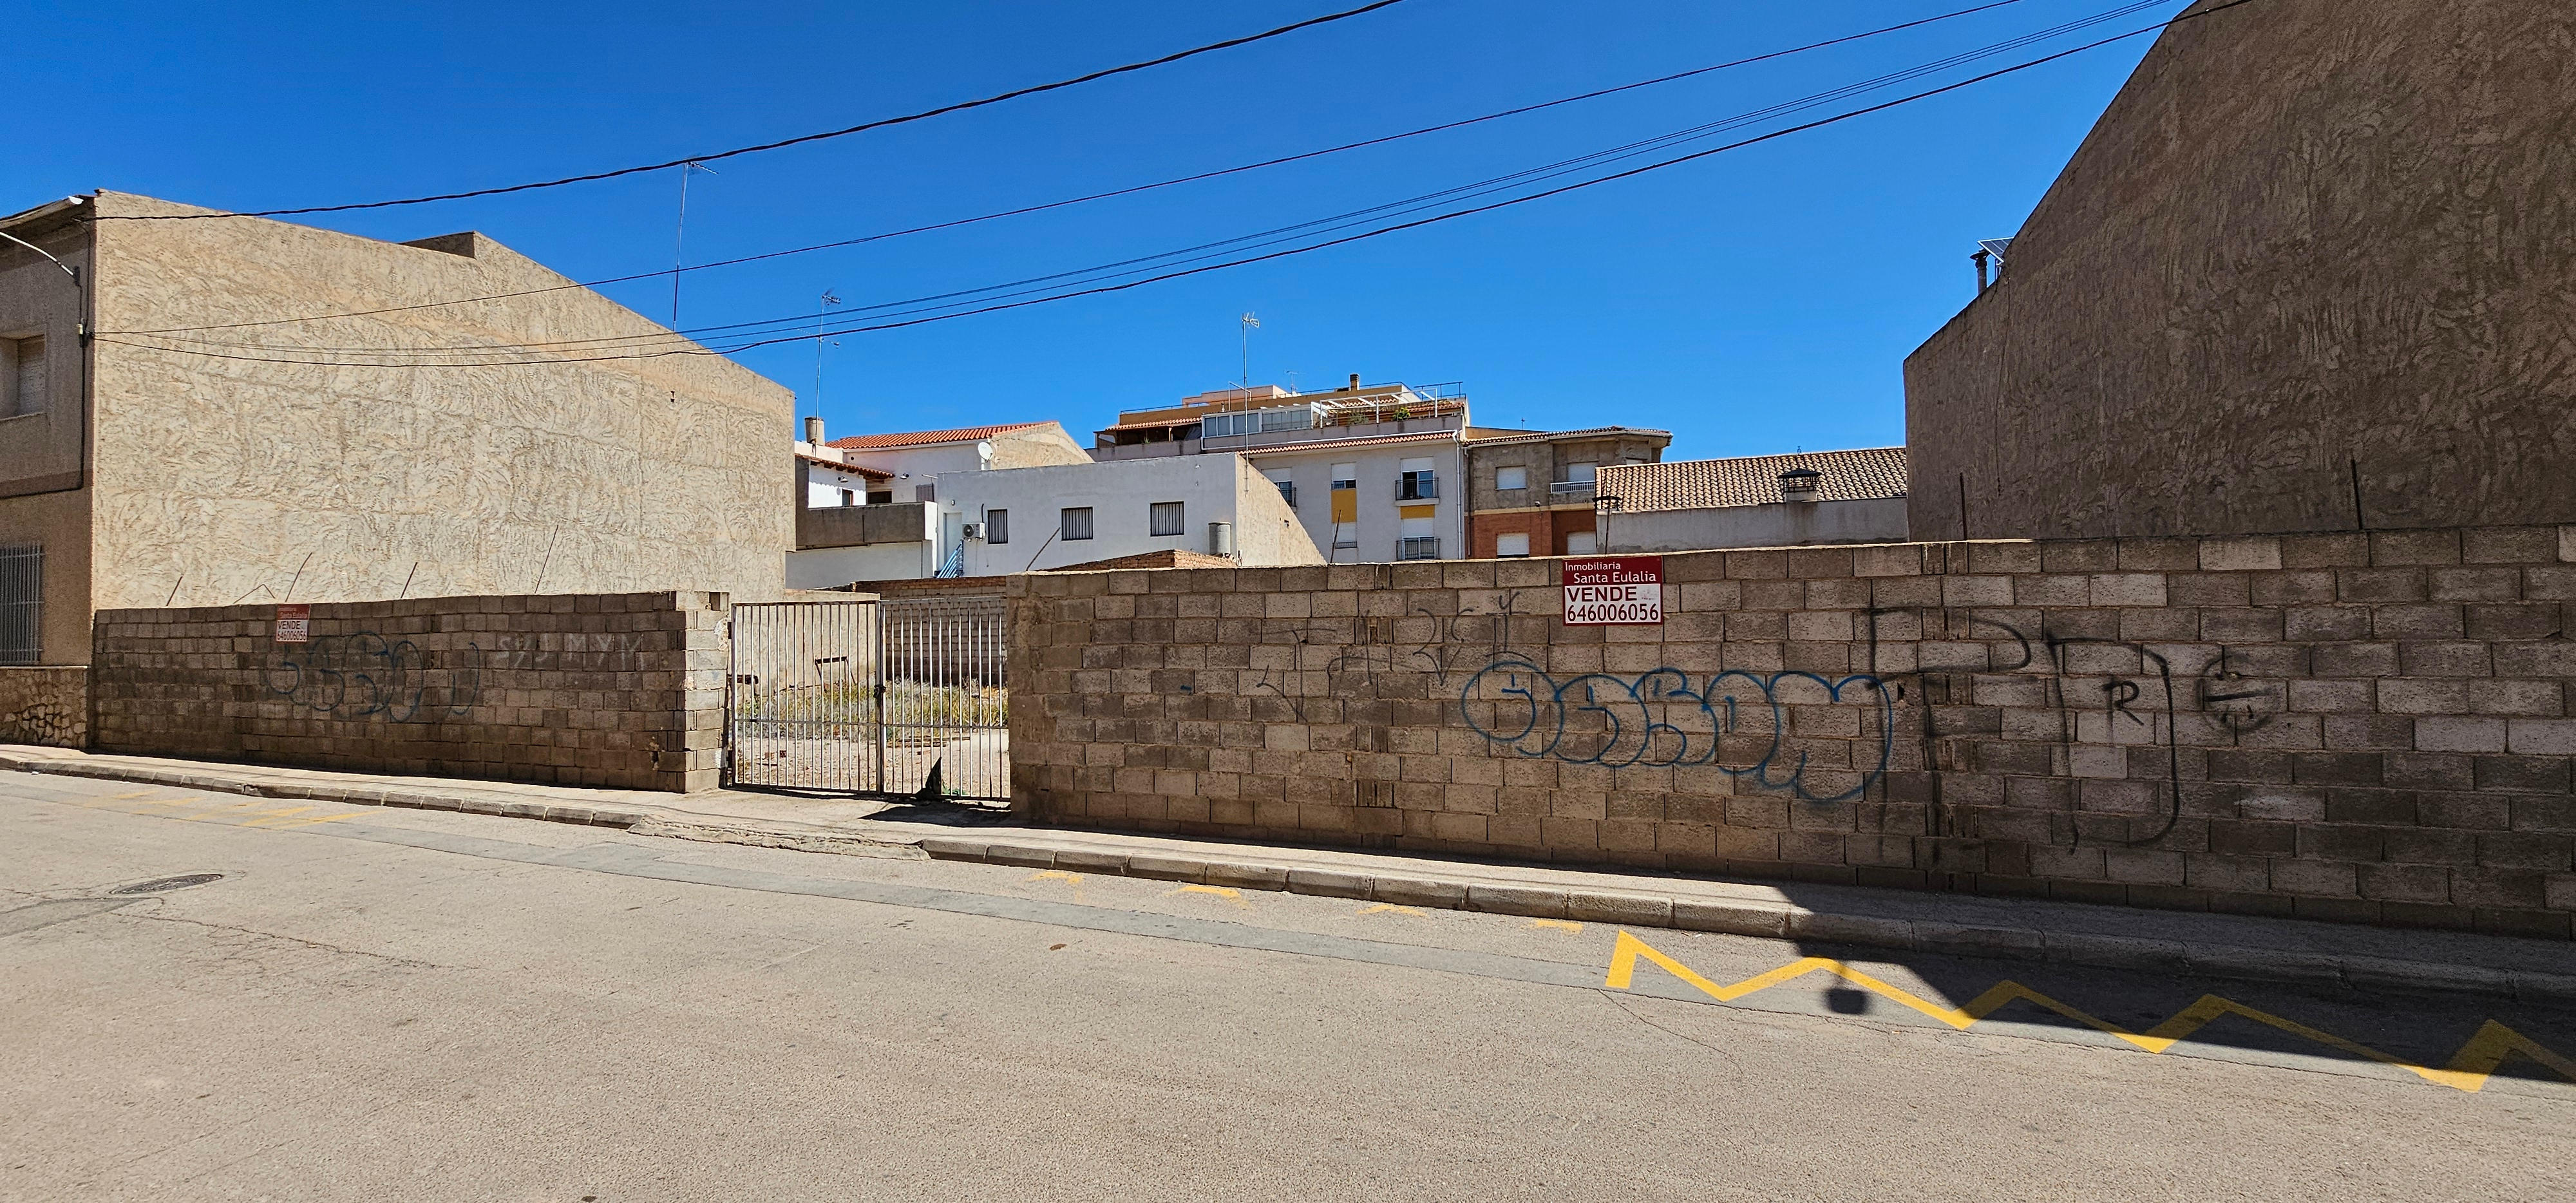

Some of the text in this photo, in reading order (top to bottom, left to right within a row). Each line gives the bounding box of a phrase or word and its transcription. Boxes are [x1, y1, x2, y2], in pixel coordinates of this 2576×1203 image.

[1565, 562, 1621, 571] Inmobiliaria
[1573, 571, 1656, 583] Santa Eulalia
[1567, 586, 1637, 602] VENDE
[1567, 603, 1658, 621] 646006056
[278, 620, 301, 629] VENDE
